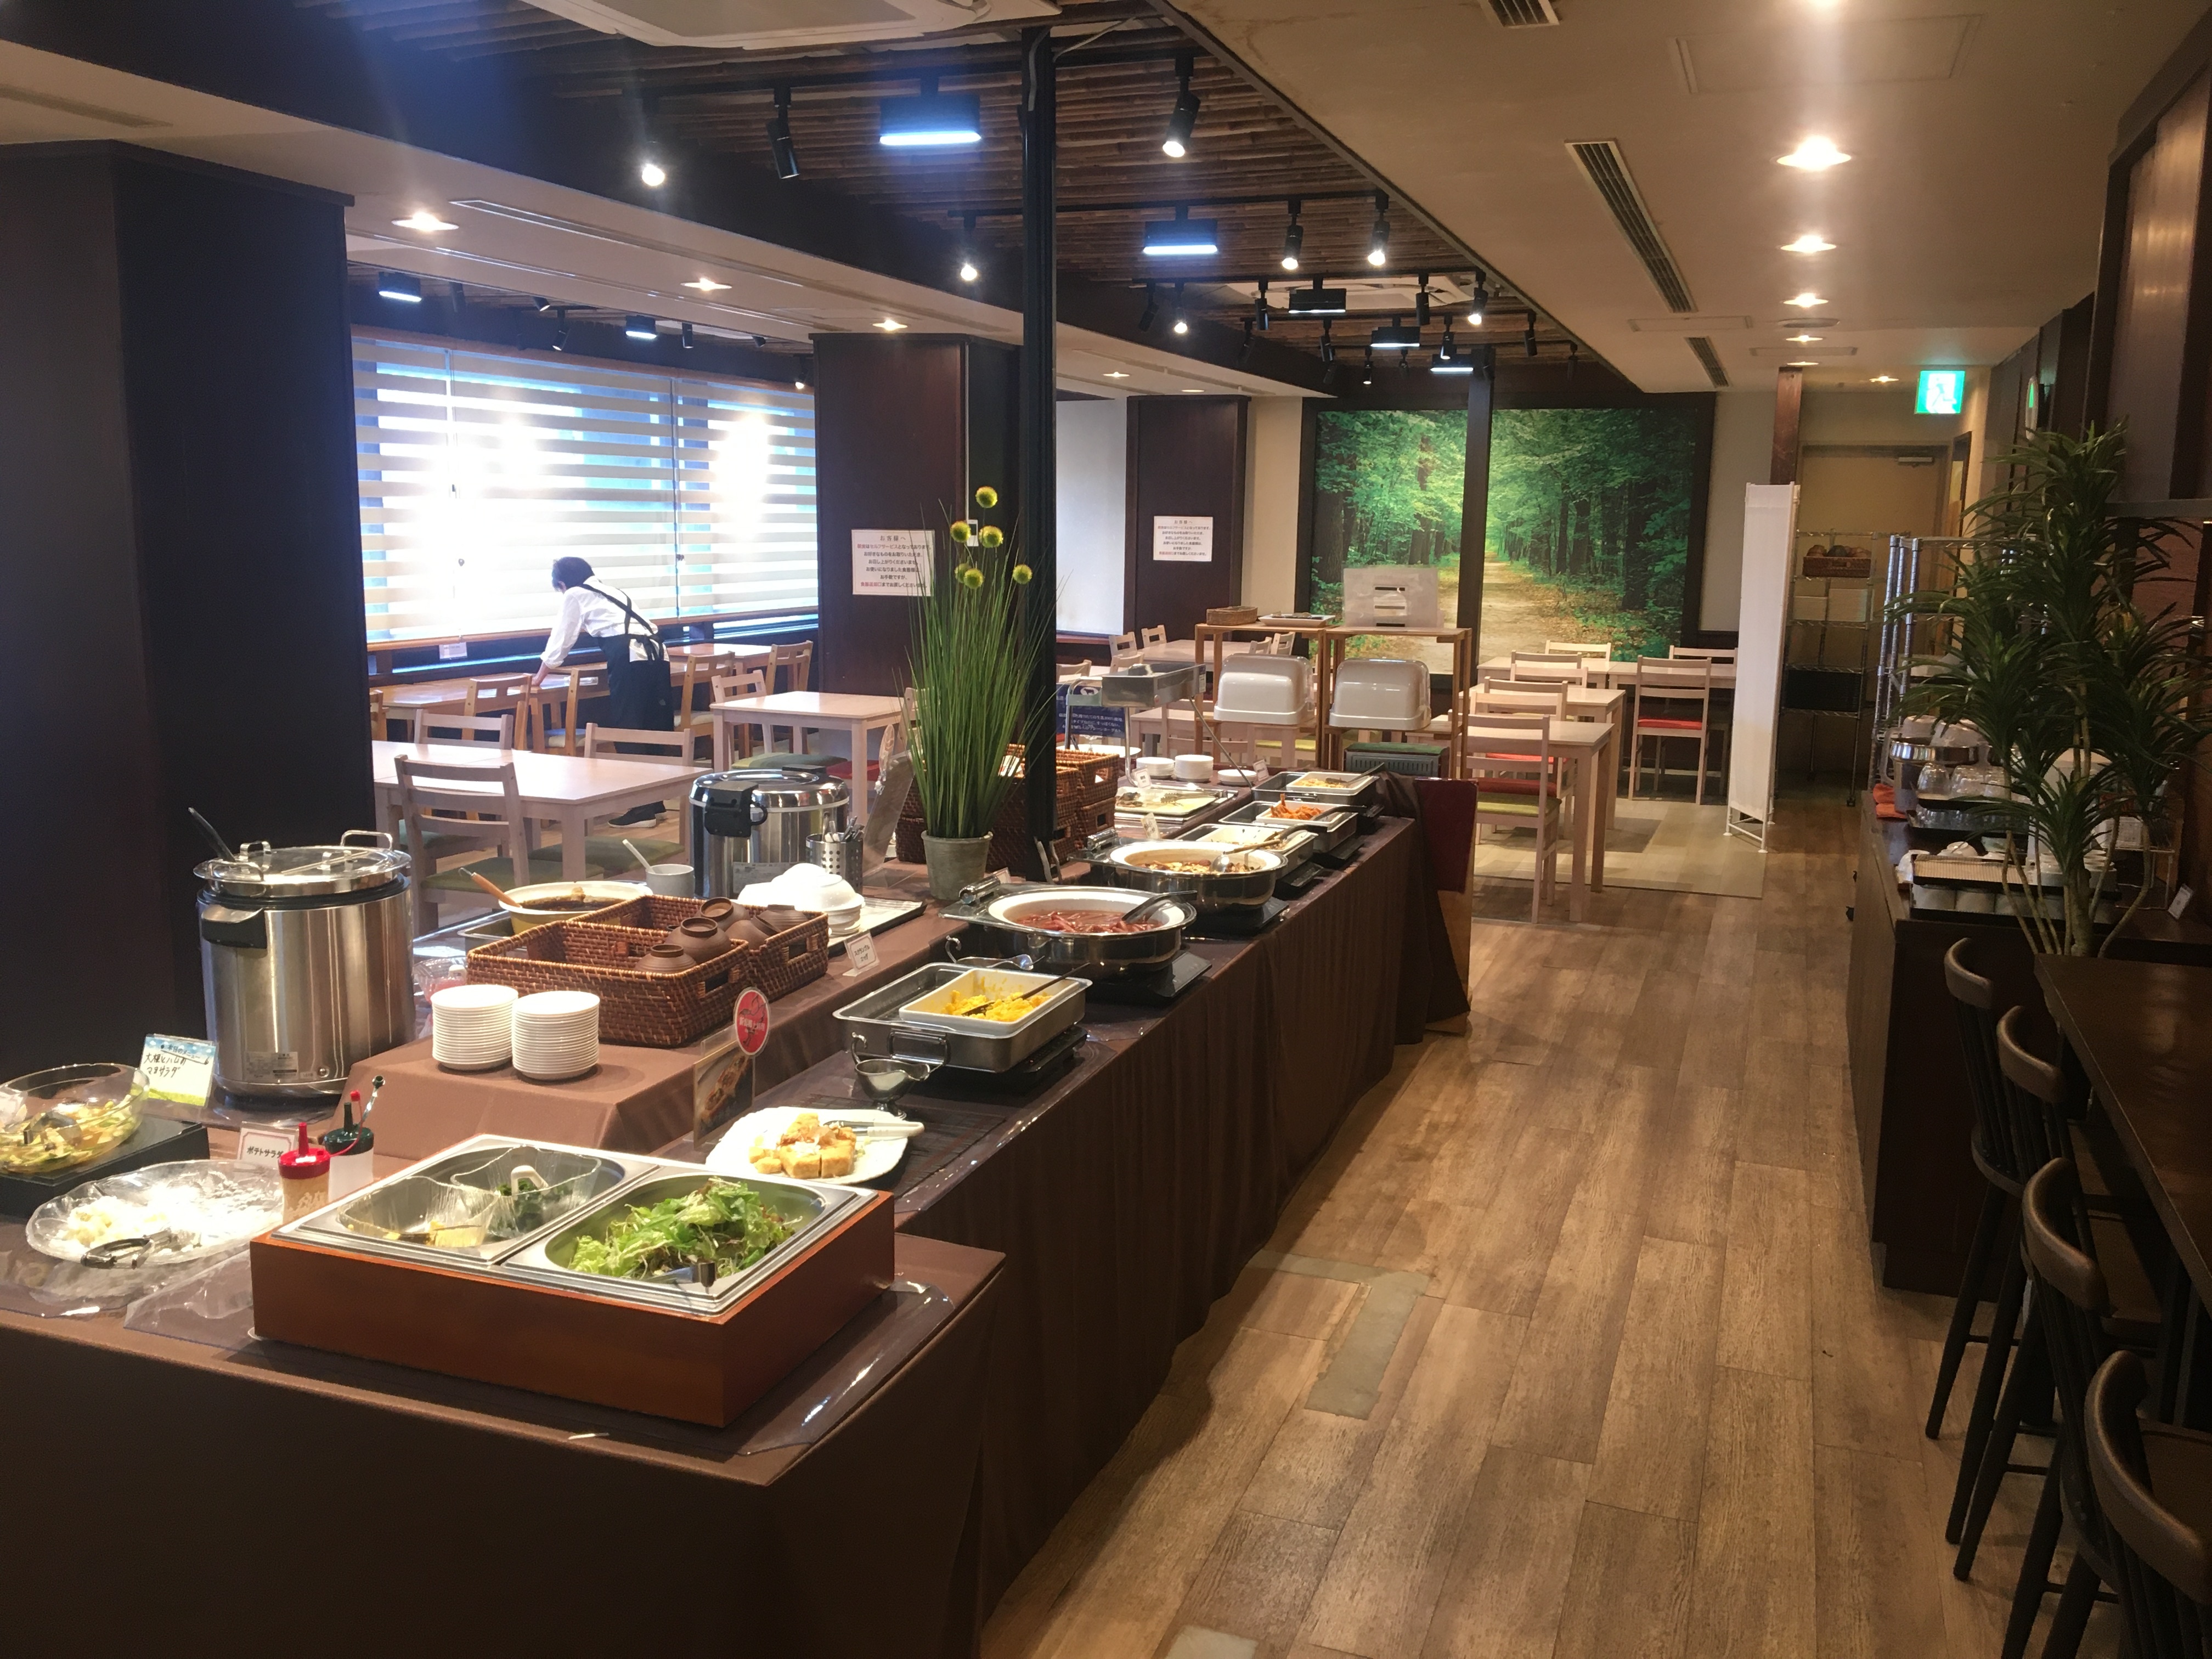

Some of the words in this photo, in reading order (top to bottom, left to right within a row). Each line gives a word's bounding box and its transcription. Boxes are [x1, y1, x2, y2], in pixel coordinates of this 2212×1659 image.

[854, 944, 870, 956] スクランブル
[167, 1044, 201, 1059] 本日のメニュー
[147, 1065, 180, 1077] マヨサラダ
[247, 1146, 284, 1159] ポテトサラダ
